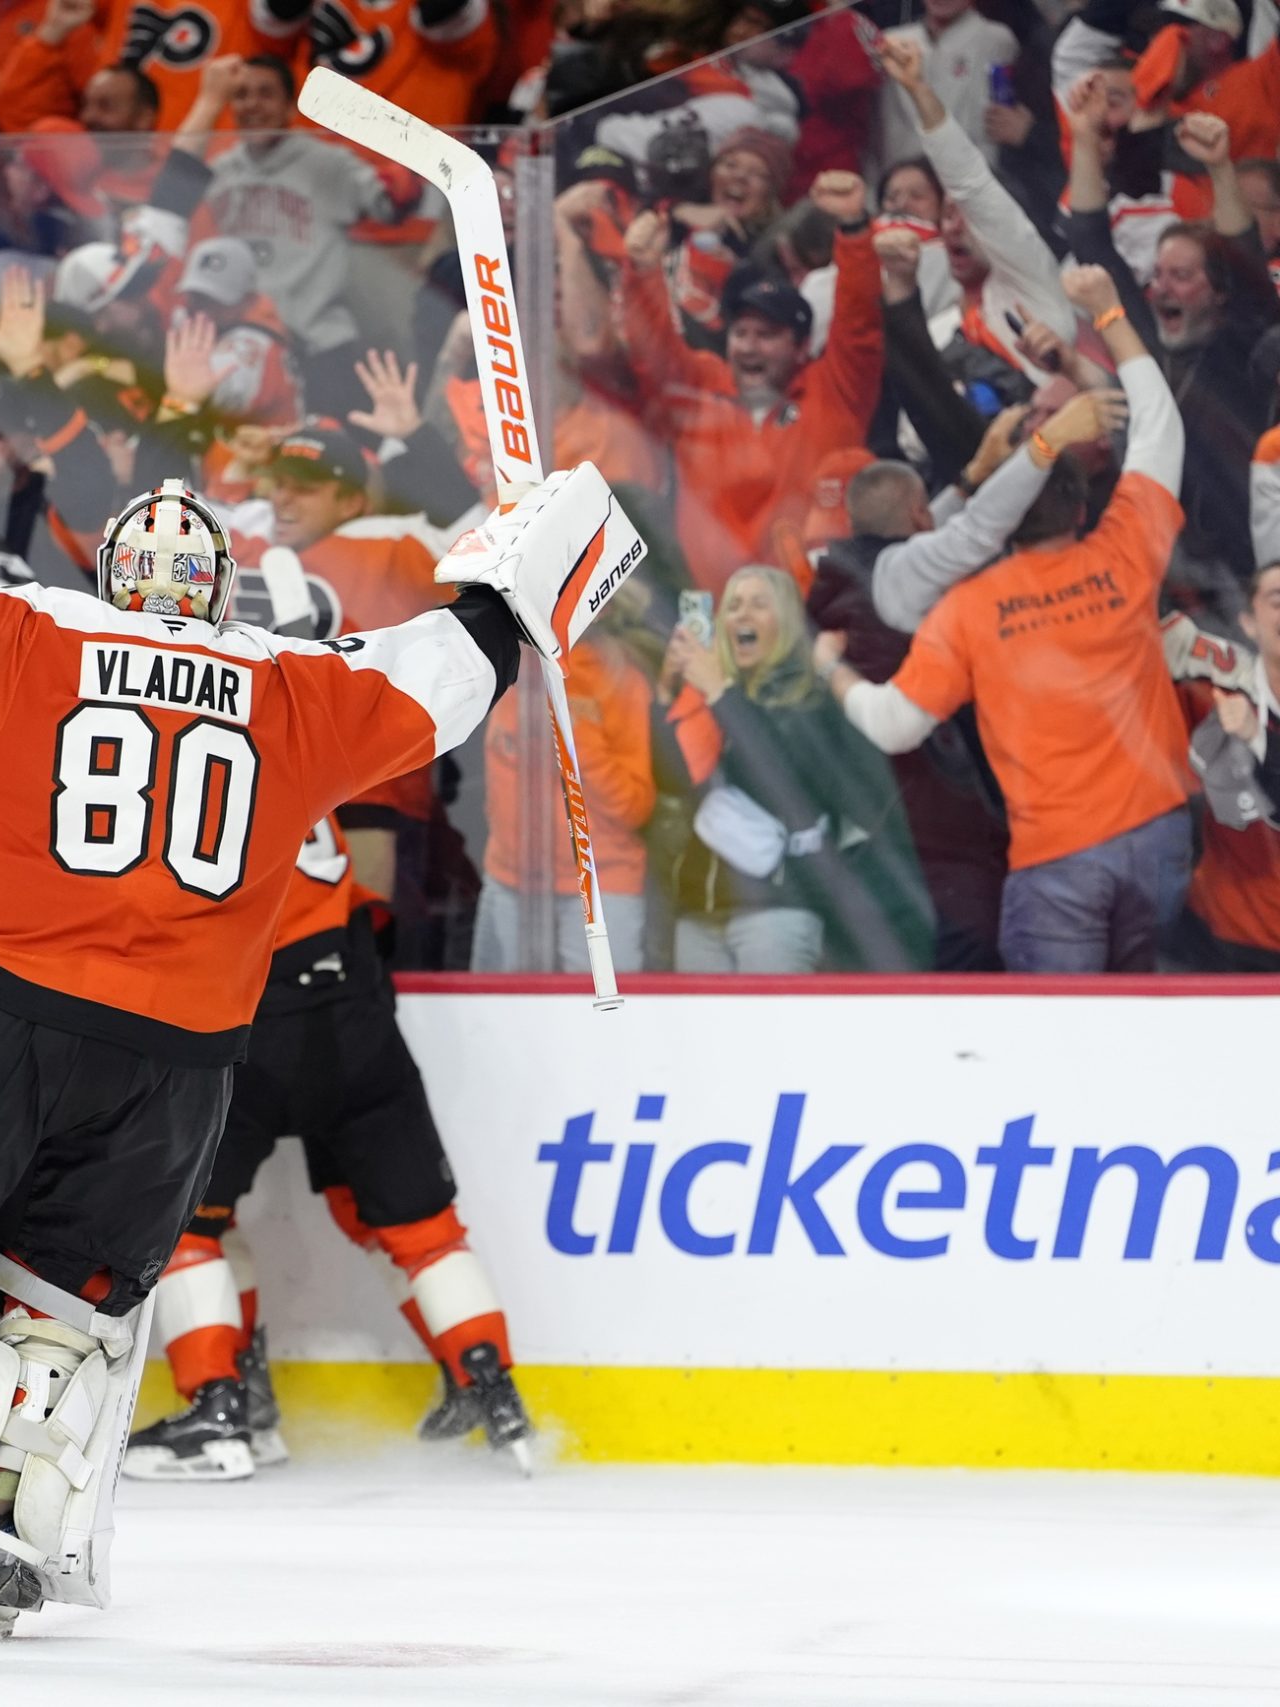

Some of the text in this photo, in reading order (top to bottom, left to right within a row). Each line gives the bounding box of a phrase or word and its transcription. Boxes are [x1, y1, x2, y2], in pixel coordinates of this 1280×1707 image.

[96, 649, 239, 717] VLADAR
[49, 699, 261, 903] 80
[566, 769, 594, 874] FLYLITE
